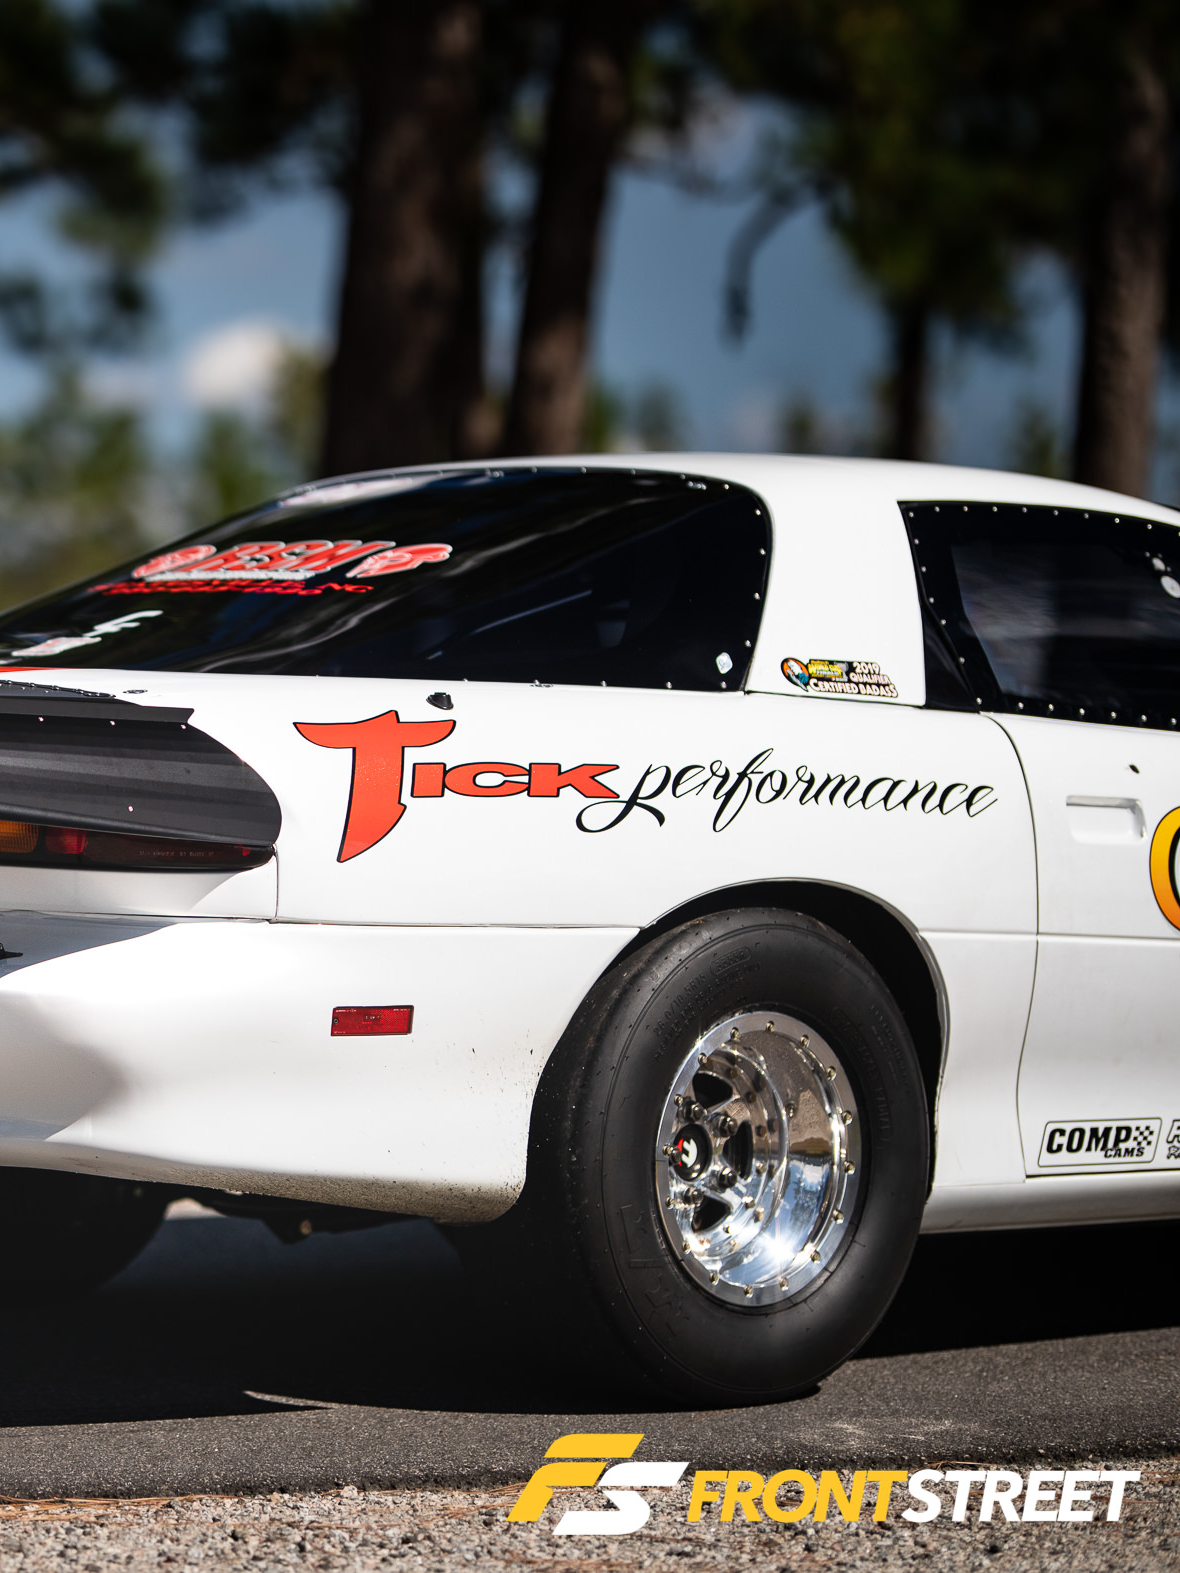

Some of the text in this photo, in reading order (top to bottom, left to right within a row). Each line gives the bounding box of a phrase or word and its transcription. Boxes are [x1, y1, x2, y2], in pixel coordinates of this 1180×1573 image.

[853, 662, 880, 675] 2019
[850, 673, 891, 684] QUALIFIER
[809, 679, 898, 697] CERTIFIED BADASS
[576, 747, 998, 833] performance
[1046, 1126, 1132, 1153] COMP
[1103, 1146, 1146, 1158] CAMS
